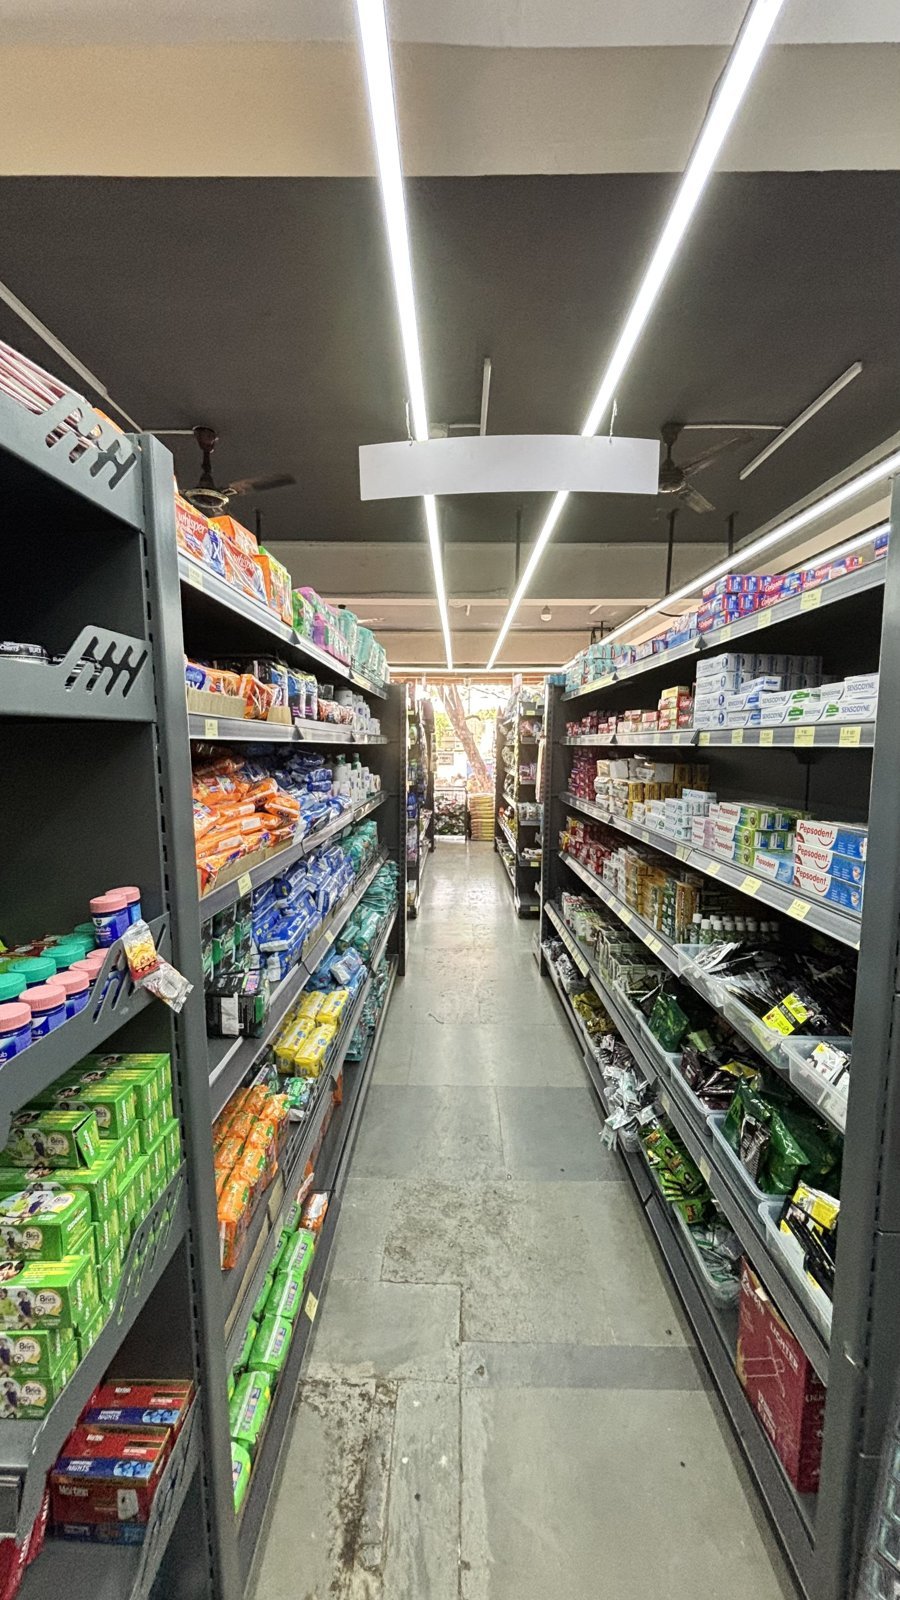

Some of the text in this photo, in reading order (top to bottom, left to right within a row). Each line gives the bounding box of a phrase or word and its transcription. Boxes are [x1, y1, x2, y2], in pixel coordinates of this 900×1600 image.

[178, 512, 207, 533] whisper
[847, 682, 875, 692] SENSODYNE
[762, 696, 786, 704] SENSODYNE
[841, 704, 871, 713] SENSODYNE
[799, 822, 833, 838] Pepsodent
[797, 844, 829, 860] Pepsodent
[756, 855, 776, 870] Pepsodent
[795, 866, 827, 885] Pepsodent
[769, 1321, 799, 1370] LIGHTER
